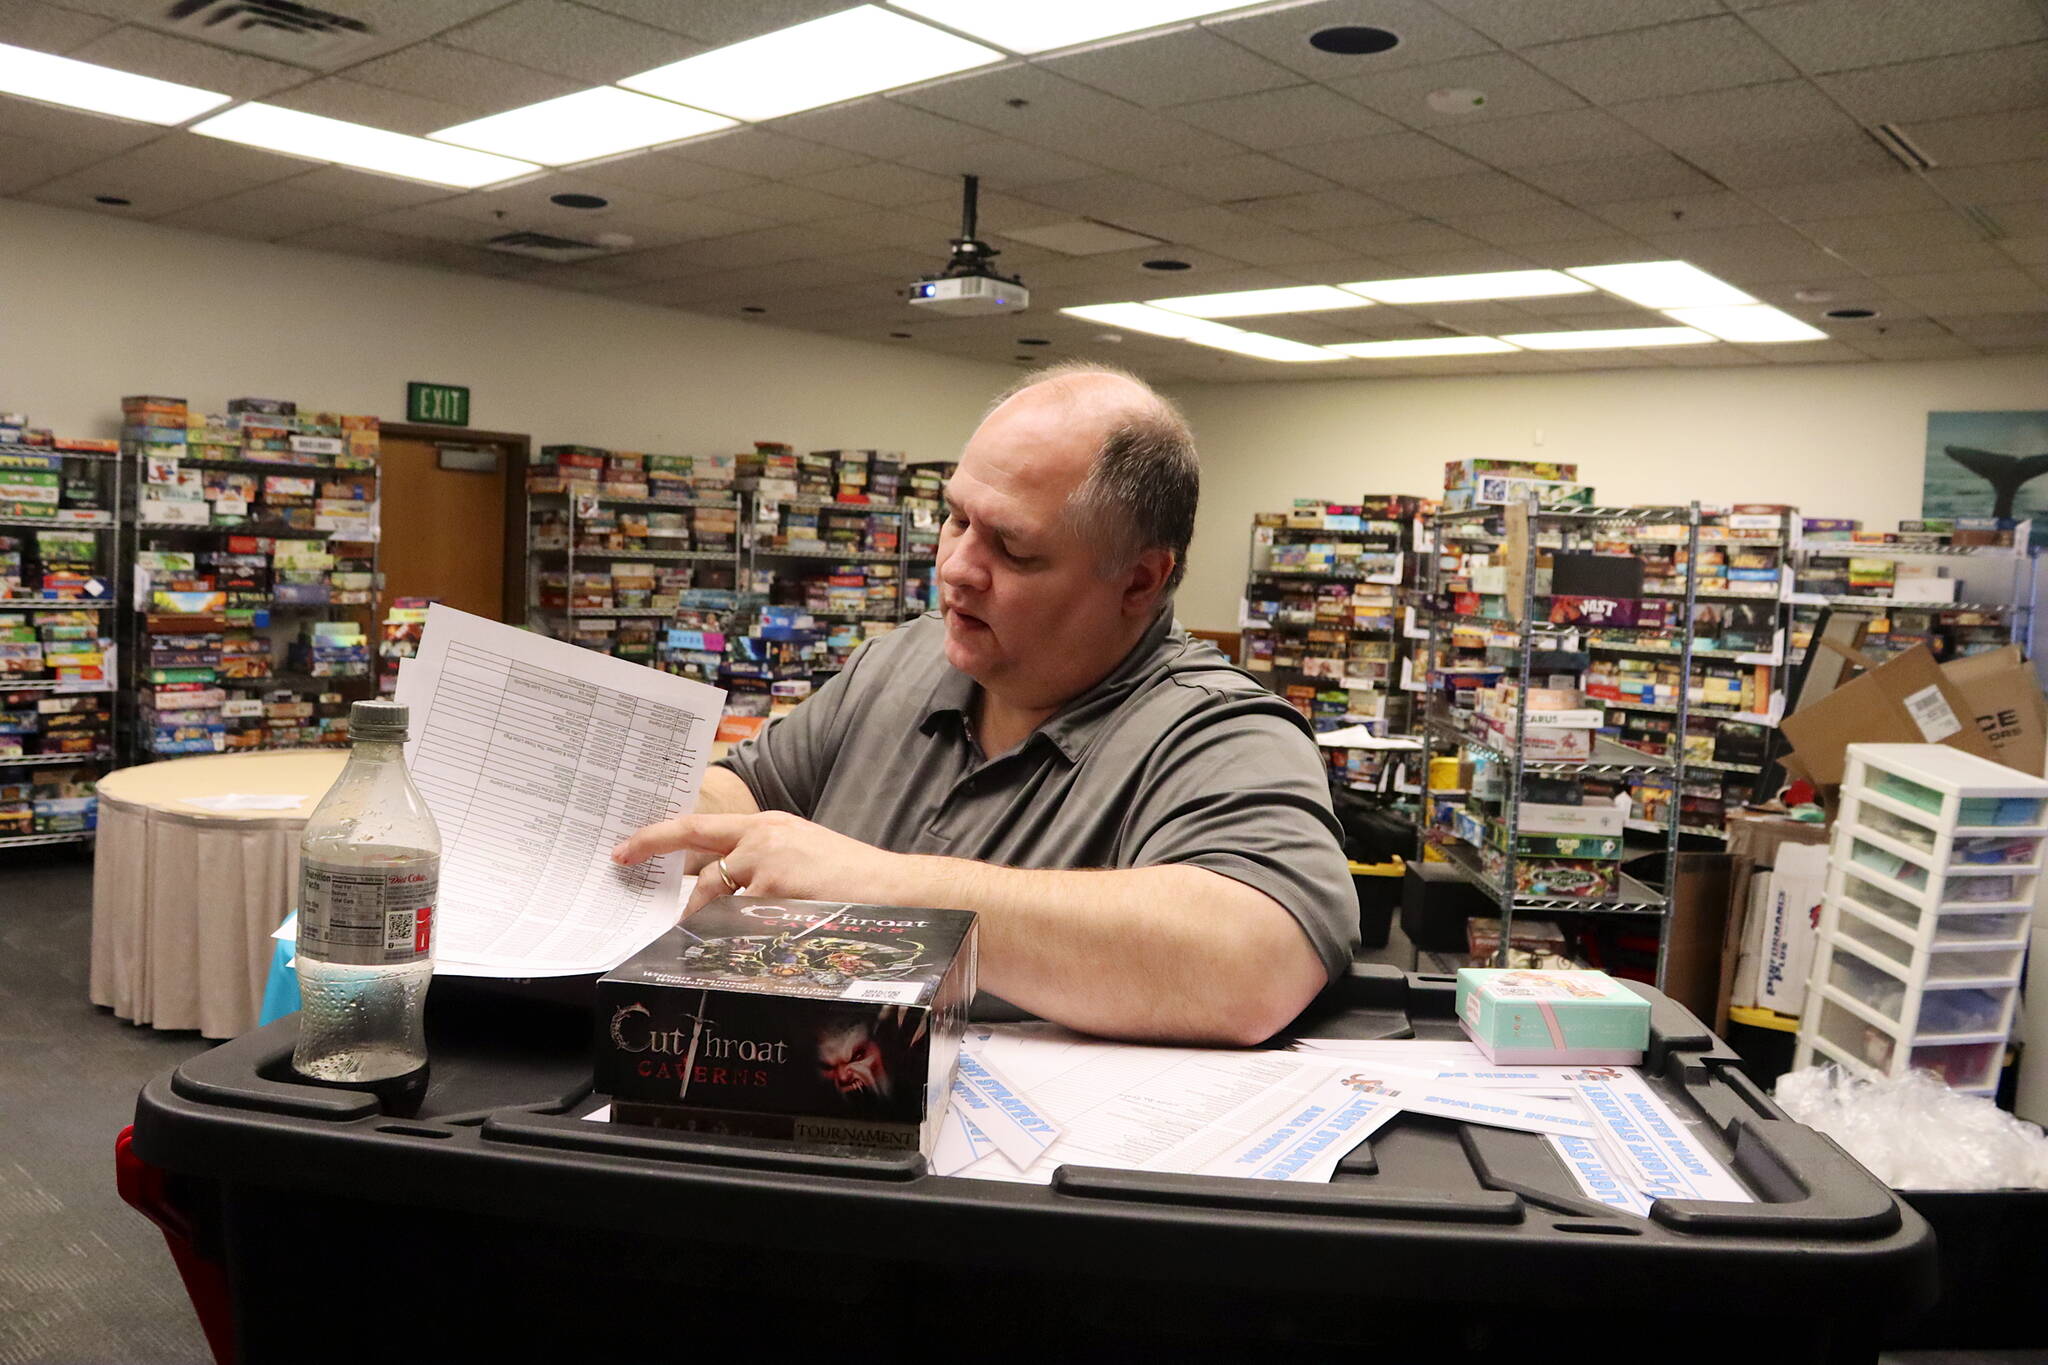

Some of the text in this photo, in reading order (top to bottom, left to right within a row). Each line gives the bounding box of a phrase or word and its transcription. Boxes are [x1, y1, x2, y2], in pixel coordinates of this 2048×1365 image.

[420, 387, 460, 421] EXIT
[638, 1058, 768, 1087] CAVERNS
[975, 1078, 1055, 1132] STRATEGY
[1287, 1105, 1326, 1128] AREA
[1579, 1084, 1644, 1141] STRATEGY
[1623, 1093, 1678, 1137] SELECTION
[797, 1123, 914, 1146] TOURNAMENT
[1262, 1099, 1379, 1180] LIGHT STRATEG
[1628, 1144, 1680, 1182] LIGHT
[1665, 1141, 1711, 1175] ACTION
[1575, 1162, 1628, 1202] LIGHT
